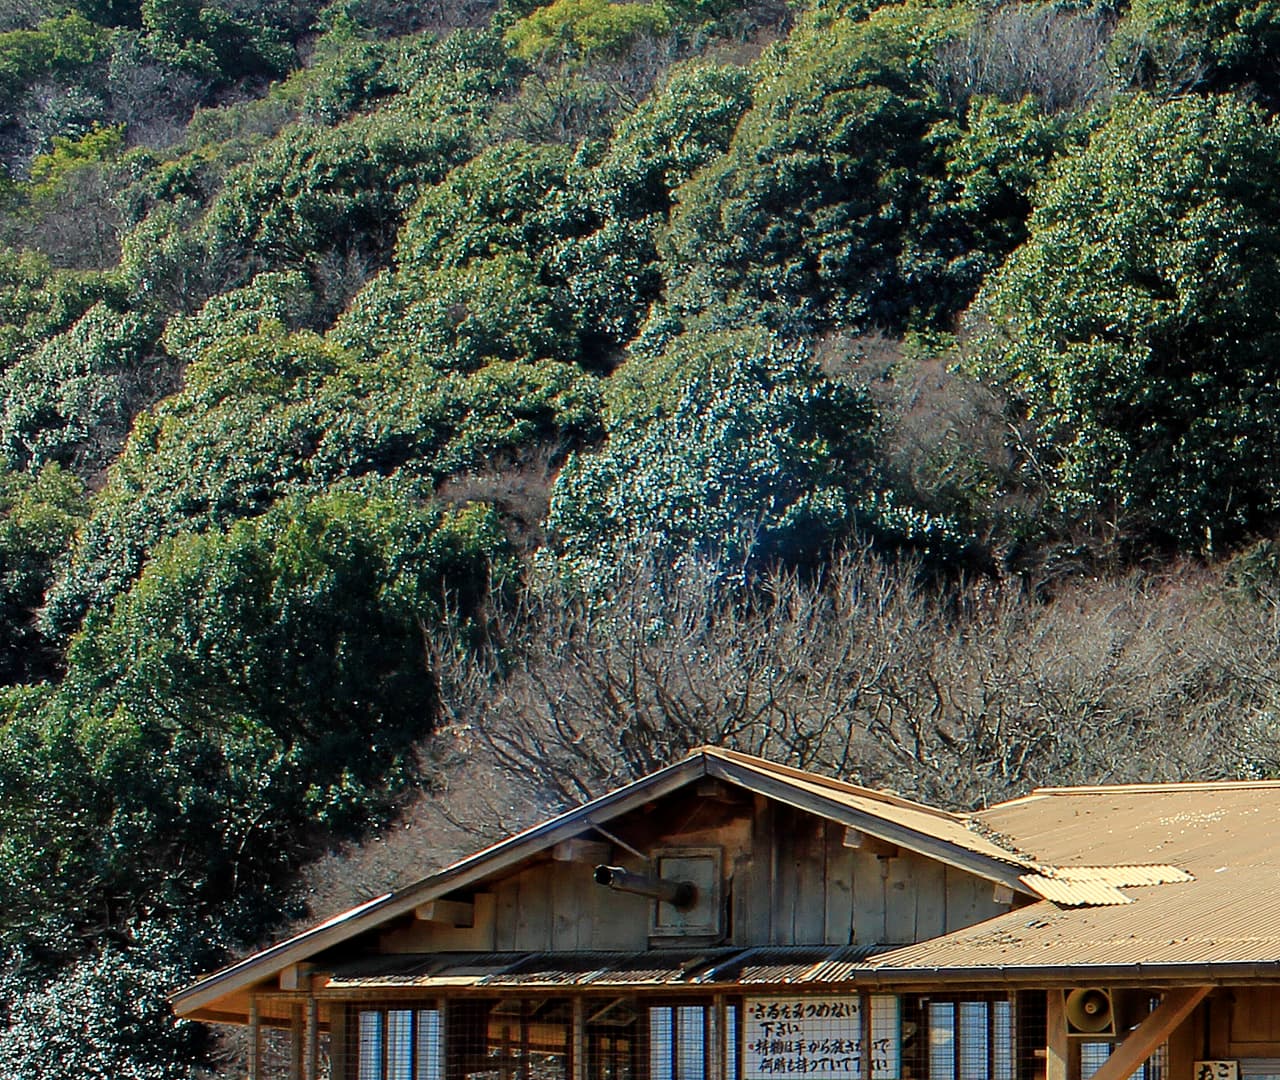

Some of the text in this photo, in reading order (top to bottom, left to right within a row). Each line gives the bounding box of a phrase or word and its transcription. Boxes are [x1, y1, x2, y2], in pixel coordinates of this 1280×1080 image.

[755, 1003, 861, 1020] さるをみつめない
